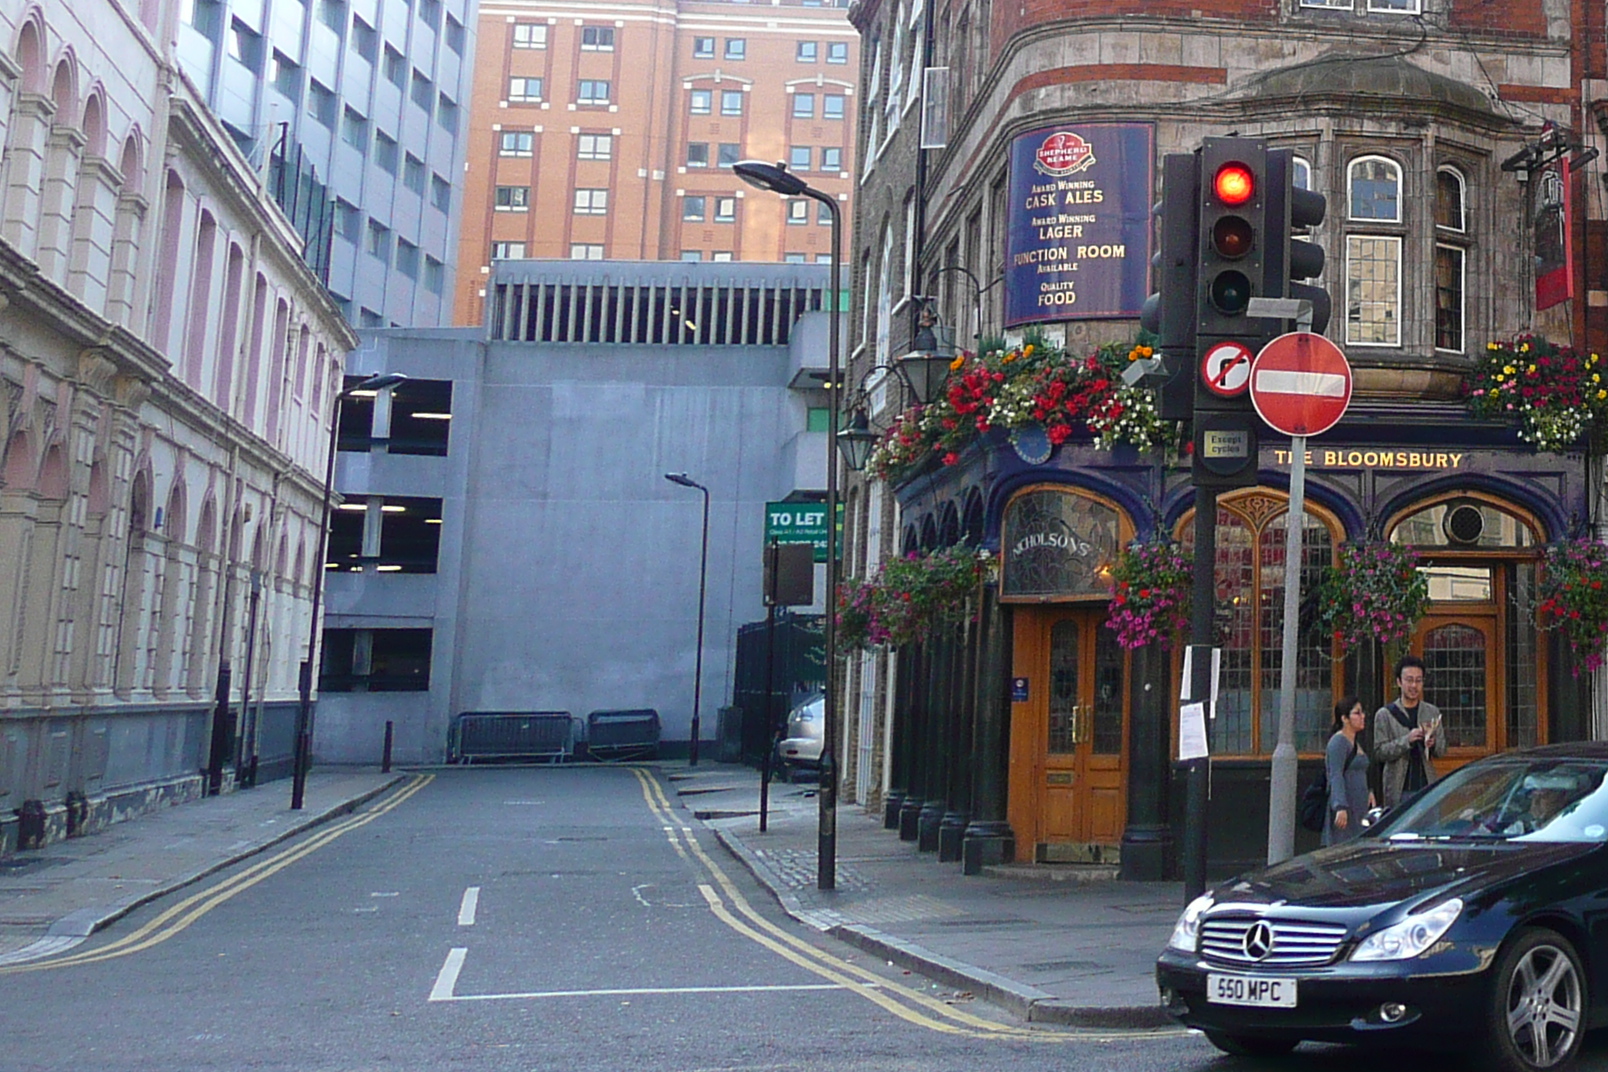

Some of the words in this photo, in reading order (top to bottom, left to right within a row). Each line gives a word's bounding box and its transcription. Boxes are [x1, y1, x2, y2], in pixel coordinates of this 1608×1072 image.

[1057, 180, 1095, 192] WINNING
[1025, 193, 1056, 210] CASK
[1065, 190, 1104, 205] ALES
[1058, 214, 1096, 225] WINNING
[1039, 225, 1083, 240] LAGER
[1013, 246, 1068, 267] FUNCTION
[1076, 244, 1126, 259] ROOM
[1038, 291, 1077, 307] FOOD
[1211, 434, 1242, 445] Except
[1211, 444, 1241, 455] cycles
[1274, 450, 1313, 465] TE
[1324, 451, 1463, 469] BLOOMSBURY
[770, 512, 792, 526] TO
[795, 512, 824, 526] LET
[1218, 978, 1243, 999] 550
